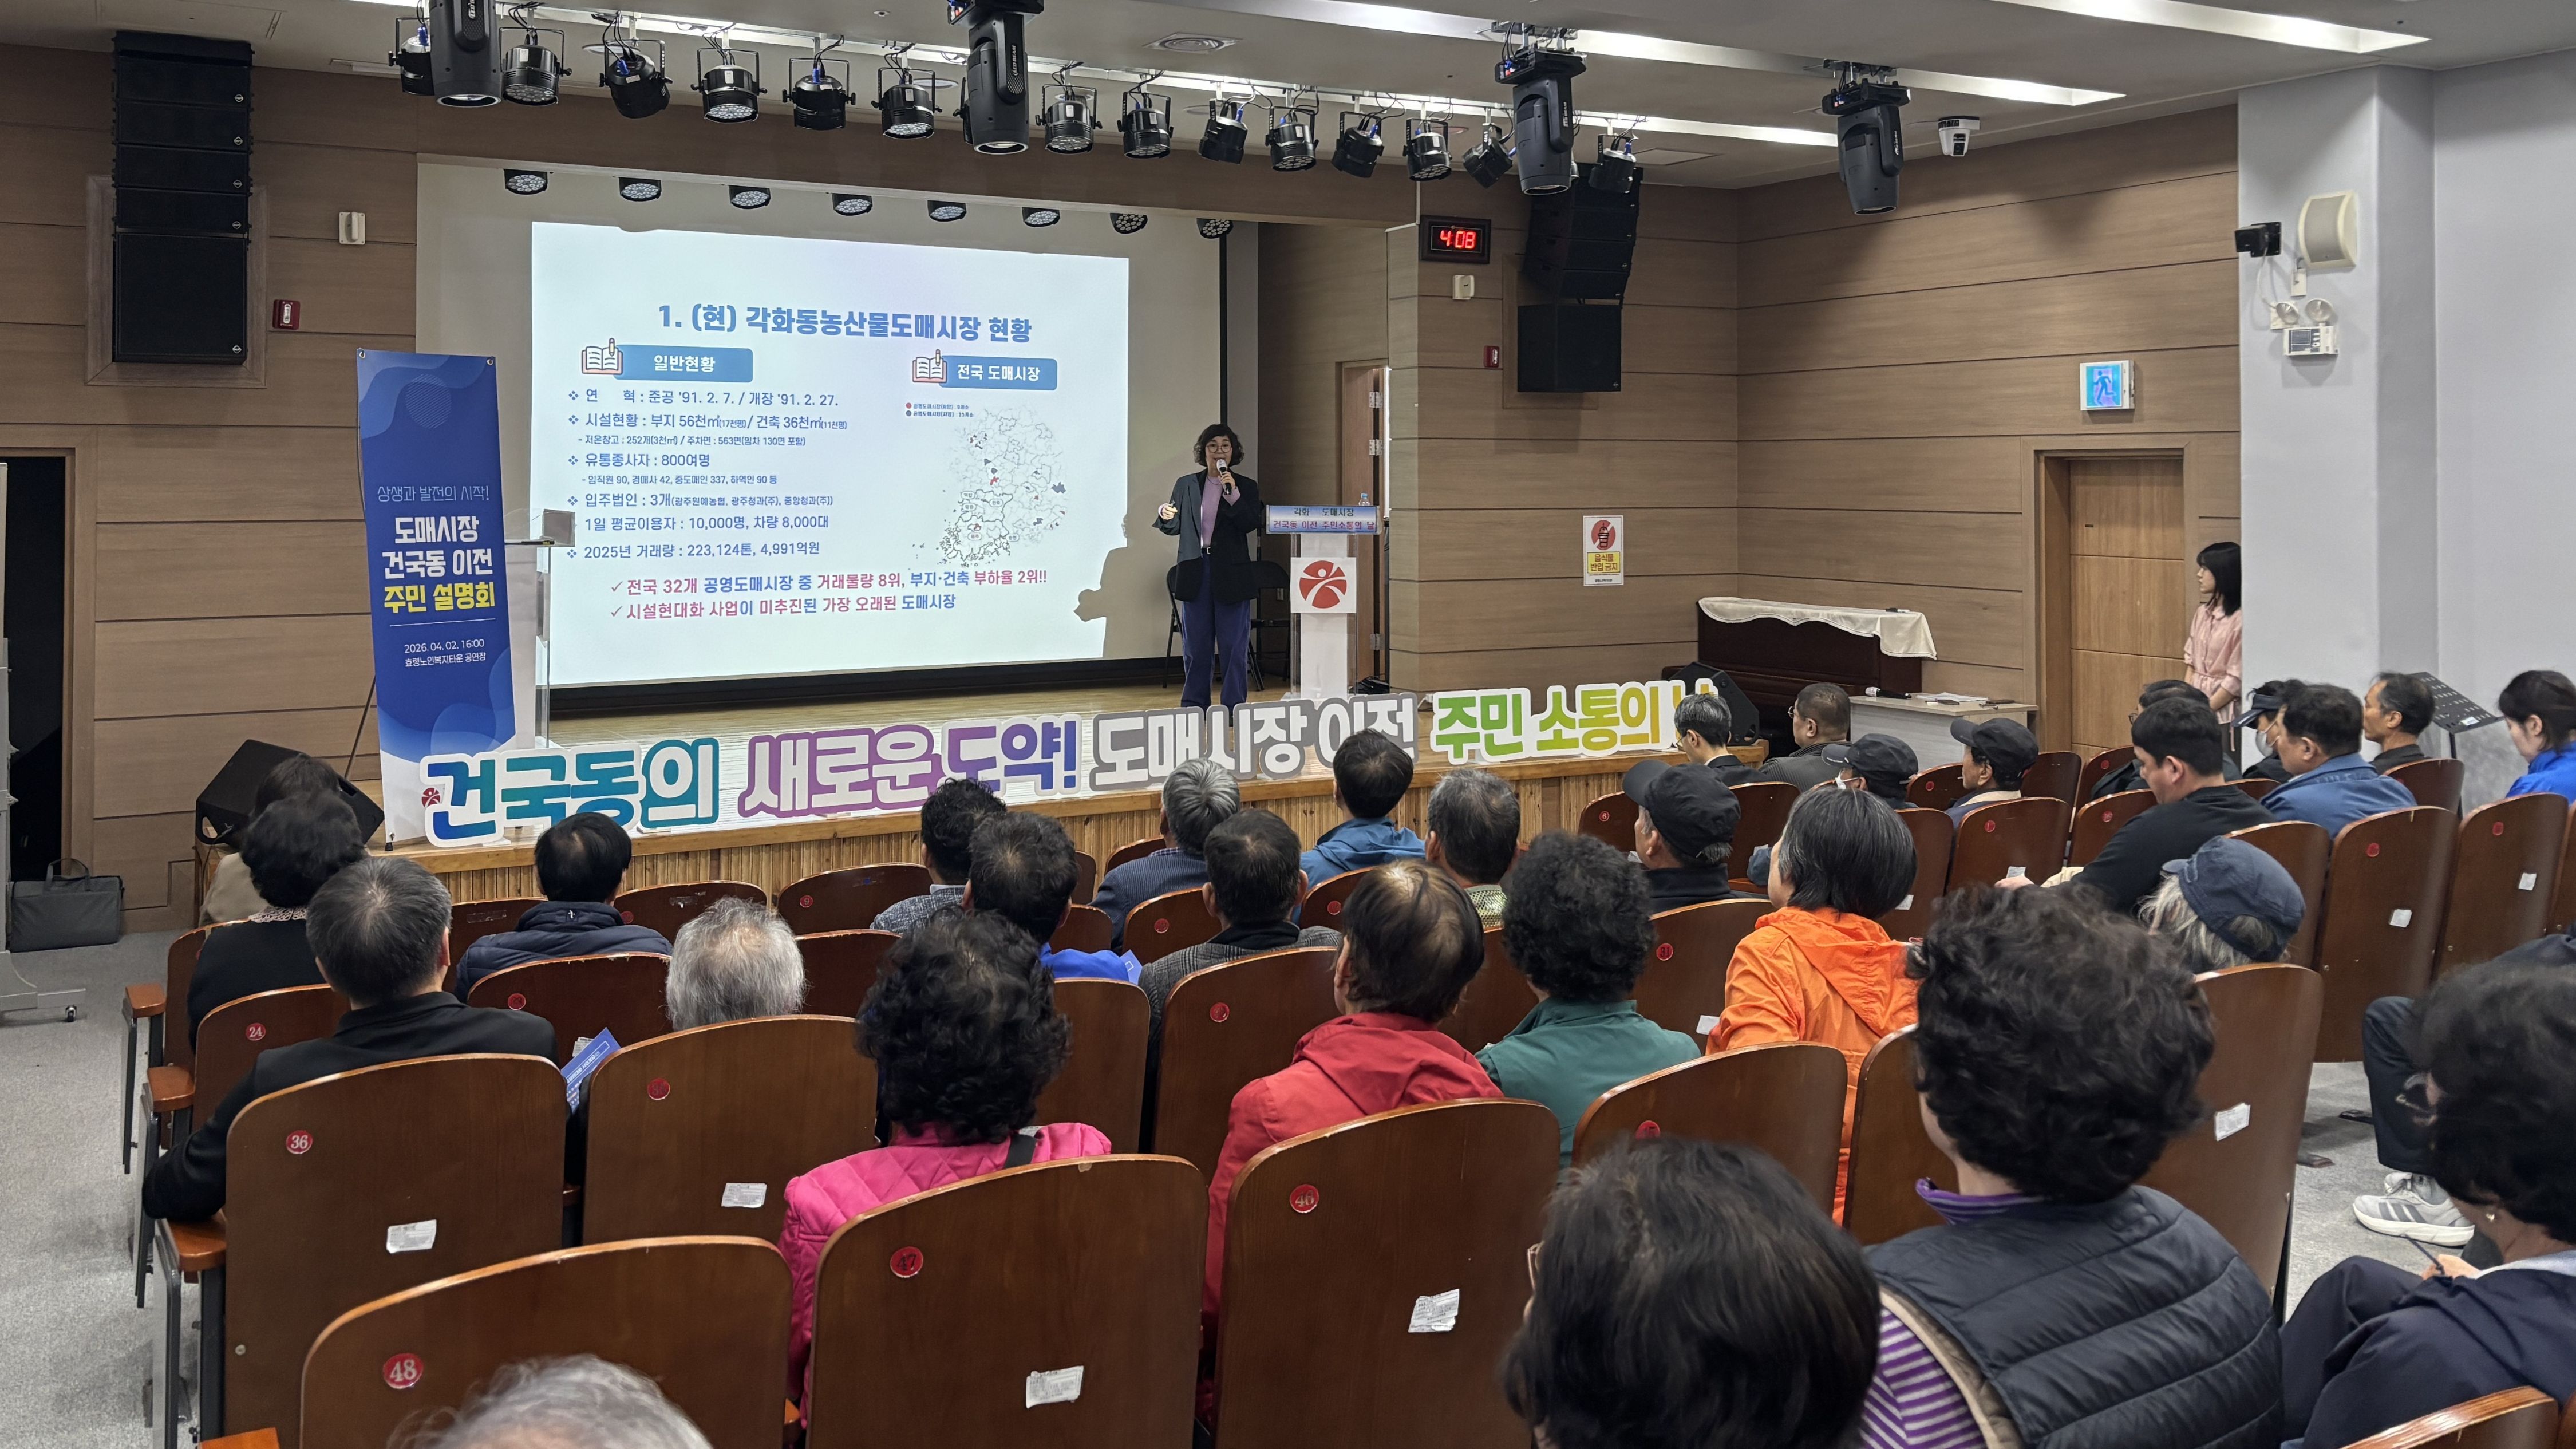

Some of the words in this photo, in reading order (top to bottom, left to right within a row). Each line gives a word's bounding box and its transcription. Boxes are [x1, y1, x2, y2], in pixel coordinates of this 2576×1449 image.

[659, 305, 682, 327] 1.
[692, 303, 737, 333] (현)
[746, 307, 981, 341] 각화동농산물도매시장
[989, 317, 1032, 343] 현황
[654, 354, 716, 373] 일반현황
[957, 365, 983, 380] 전국
[988, 365, 1040, 381] 도매시장
[586, 389, 598, 402] 연
[623, 389, 635, 403] 혁
[649, 390, 674, 404] 준공
[707, 392, 718, 404] 2.
[724, 392, 734, 404] 7.
[749, 392, 773, 405] 개장
[804, 394, 815, 405] 2.
[820, 395, 839, 406] 27.
[586, 413, 638, 427] 시설현황
[651, 414, 675, 428] 부지
[757, 416, 780, 429] 건축
[586, 435, 619, 445] 저온창고
[688, 436, 711, 445] 주차면
[718, 437, 760, 446] 563면(임차
[763, 437, 785, 446] 130면
[788, 437, 806, 446] 포함)
[586, 453, 650, 467] 유통종사자
[662, 453, 710, 467] 800여명
[588, 476, 614, 485] 임직원
[617, 476, 630, 485] 90,
[632, 475, 657, 484] 경매사
[660, 476, 673, 485] 42,
[675, 475, 708, 484] 중도매인
[710, 476, 728, 484] 337,
[731, 475, 754, 484] 하역인
[757, 476, 767, 484] 90
[769, 475, 777, 484] 등
[377, 486, 416, 502] 상생과
[420, 486, 456, 501] 발전의
[461, 485, 489, 501] 시작!
[586, 493, 637, 507] 입주법인
[1294, 508, 1309, 516] 각화
[1322, 508, 1354, 516] 도매시장
[395, 516, 479, 543] 도매시장
[586, 518, 606, 531] 1일
[611, 517, 676, 531] 평균이용자
[689, 516, 749, 530] 10,000명,
[753, 516, 779, 529] 차량
[782, 515, 829, 529] 8,000대
[1274, 520, 1297, 529] 건국동
[1302, 520, 1317, 529] 이전
[1322, 521, 1362, 530] 주민소통의
[584, 545, 631, 558] 2025년
[637, 544, 675, 558] 거래량
[688, 543, 756, 558] 223,124톤,
[761, 542, 820, 556] 4,991억원
[382, 550, 447, 579] 건국동
[452, 548, 493, 575] 이전
[1590, 563, 1603, 571] 반입
[1605, 563, 1618, 571] 금지
[627, 578, 657, 595] 전국
[663, 578, 697, 593] 32개
[704, 575, 793, 593] 공영도매시장
[798, 575, 812, 590] 중
[817, 574, 874, 590] 거래물량
[878, 573, 905, 589] 8위,
[910, 571, 970, 587] 부지·건축
[974, 570, 1013, 585] 부하율
[1018, 570, 1046, 584] 2위!!
[384, 585, 427, 613] 주민
[433, 581, 495, 611] 설명회
[627, 602, 704, 619] 시설현대화
[709, 600, 753, 617] 사업이
[760, 598, 816, 615] 미추진된
[823, 597, 851, 613] 가장
[855, 595, 896, 611] 오래된
[902, 594, 956, 610] 도매시장
[404, 643, 429, 653] 2026.
[430, 642, 444, 652] 04.
[446, 641, 459, 650] 02.
[461, 639, 485, 649] 16:00
[405, 654, 463, 667] 효령노인복지타운
[465, 652, 486, 662] 공연장
[426, 739, 719, 840] 건국동의
[742, 726, 934, 815] 새로운
[947, 720, 1077, 791] 도약!
[1094, 704, 1309, 786] 도매시장
[1436, 693, 1523, 759] 주민
[1536, 686, 1660, 751] 소통의
[250, 1026, 263, 1037] 24
[291, 1135, 308, 1149] 36
[1295, 1189, 1315, 1207] 46
[898, 1253, 917, 1271] 47
[390, 1359, 417, 1382] 48
